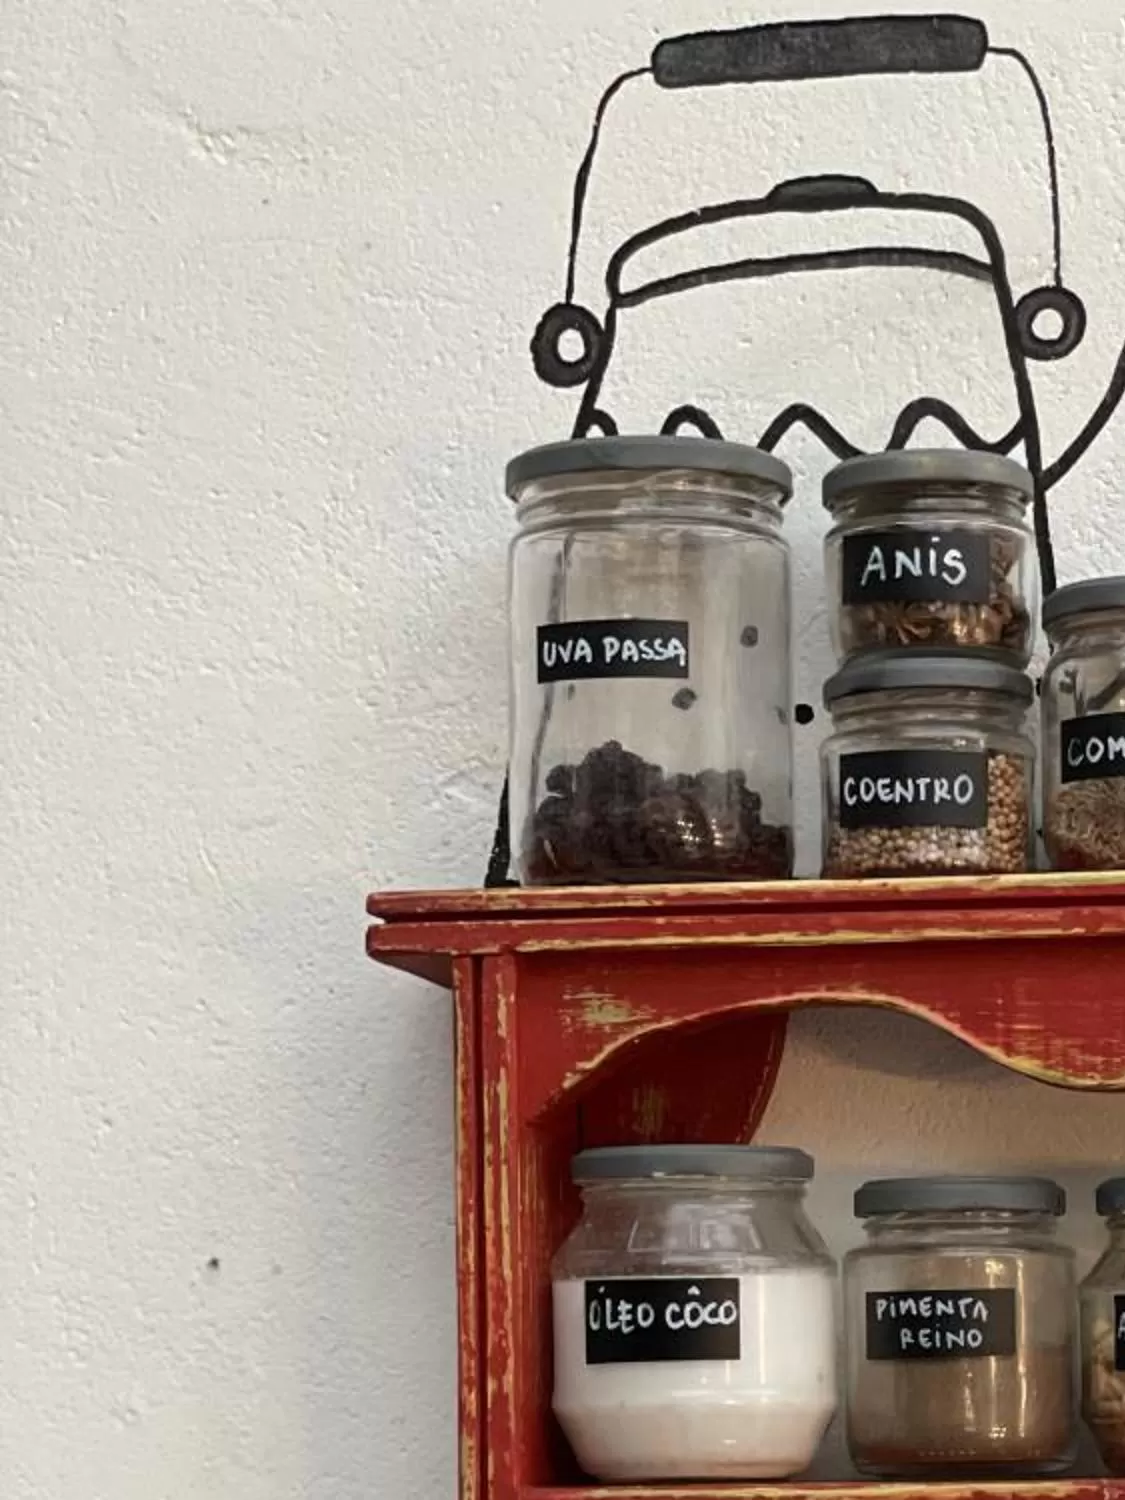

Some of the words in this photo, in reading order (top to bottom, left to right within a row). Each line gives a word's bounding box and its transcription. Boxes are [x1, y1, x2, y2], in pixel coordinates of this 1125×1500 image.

[543, 637, 592, 667] UVA
[602, 636, 686, 667] PASSA
[843, 773, 974, 805] COENTRO
